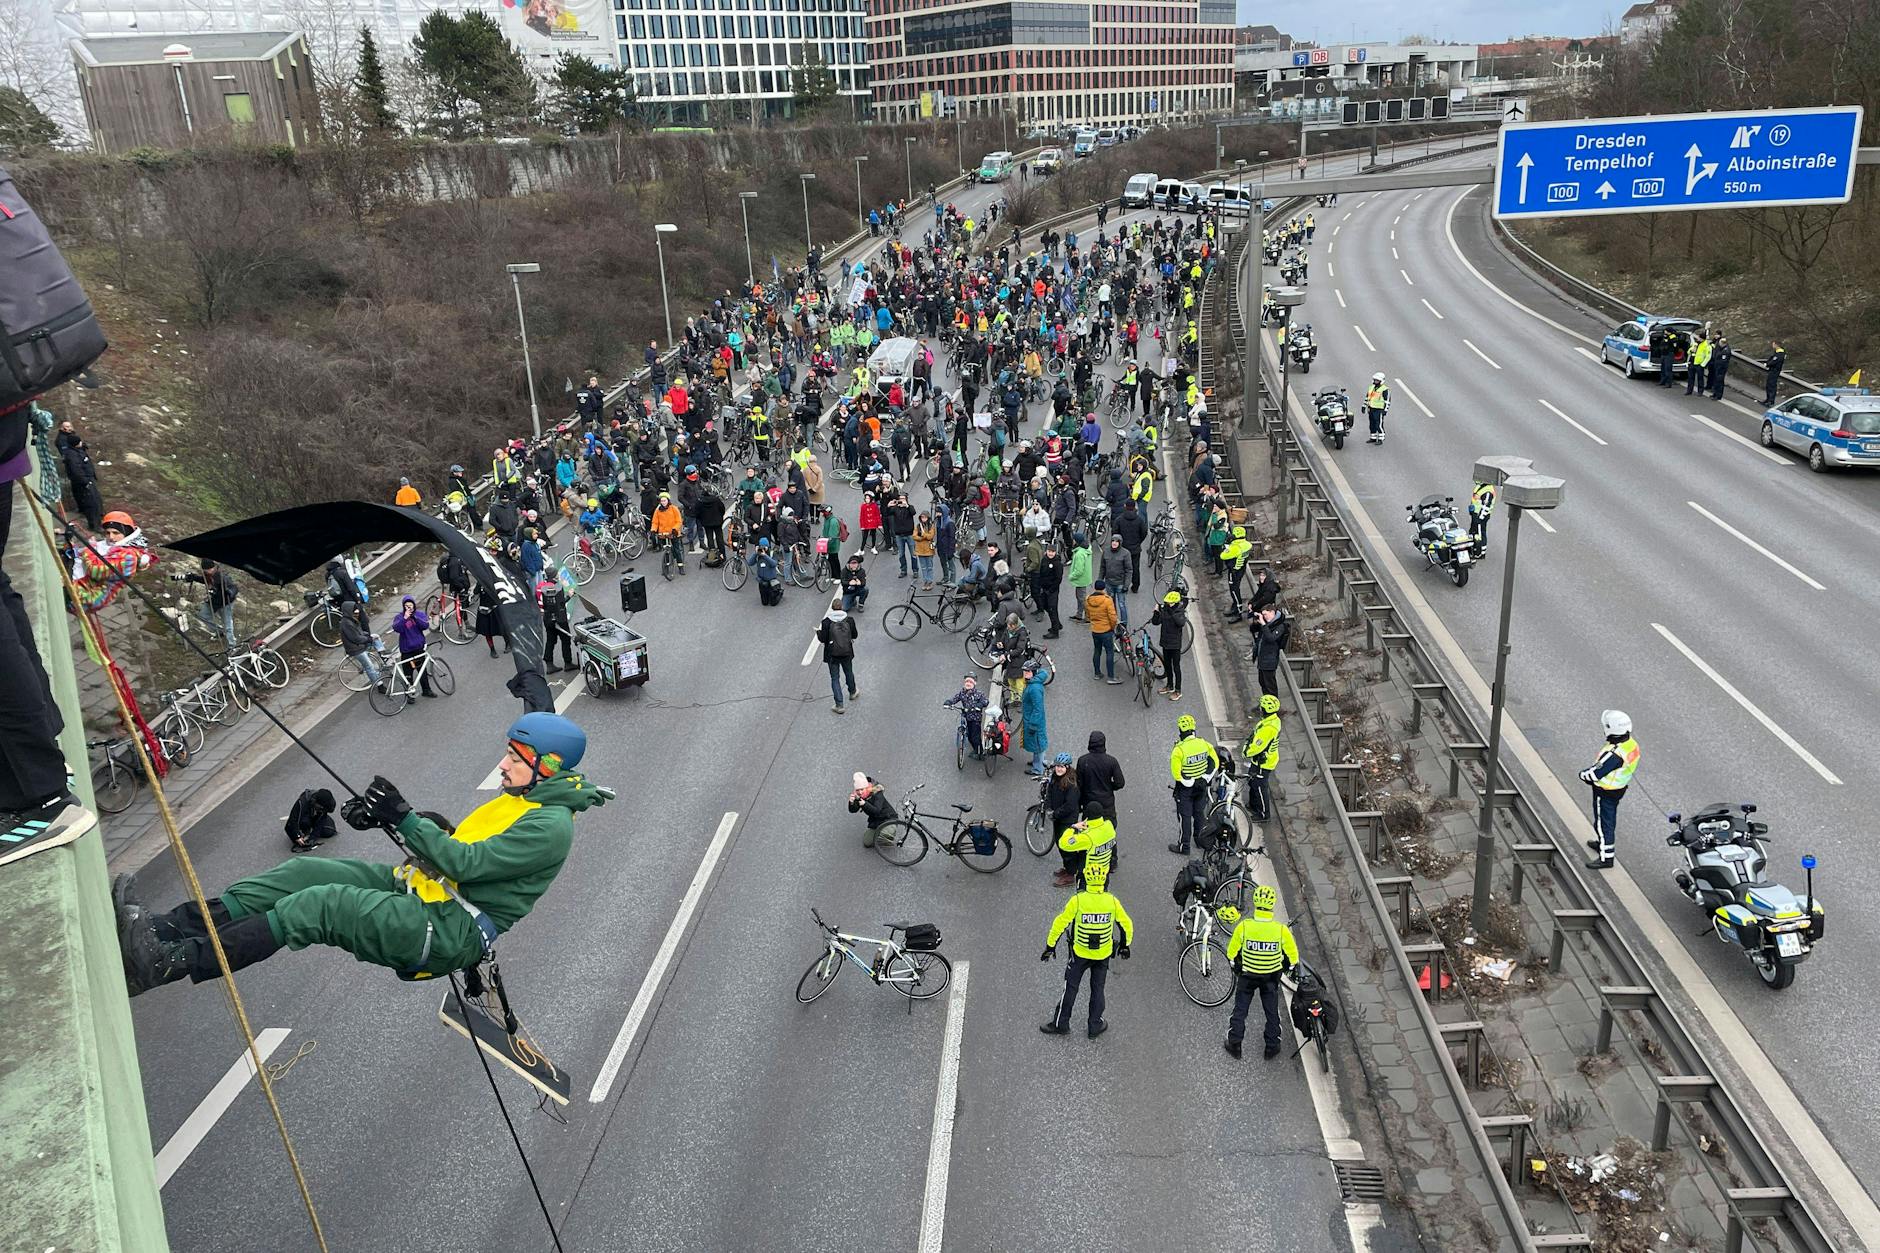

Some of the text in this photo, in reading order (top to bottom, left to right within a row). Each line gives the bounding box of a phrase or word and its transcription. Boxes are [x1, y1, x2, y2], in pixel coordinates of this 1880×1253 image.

[1313, 52, 1327, 62] DB
[1773, 129, 1787, 141] 19
[1576, 133, 1646, 150] Dresden
[1565, 152, 1654, 173] Tempelhof
[1727, 153, 1837, 172] Alboinstraße
[1553, 186, 1574, 198] 100
[1638, 182, 1659, 194] 100
[1724, 182, 1761, 194] 550 m
